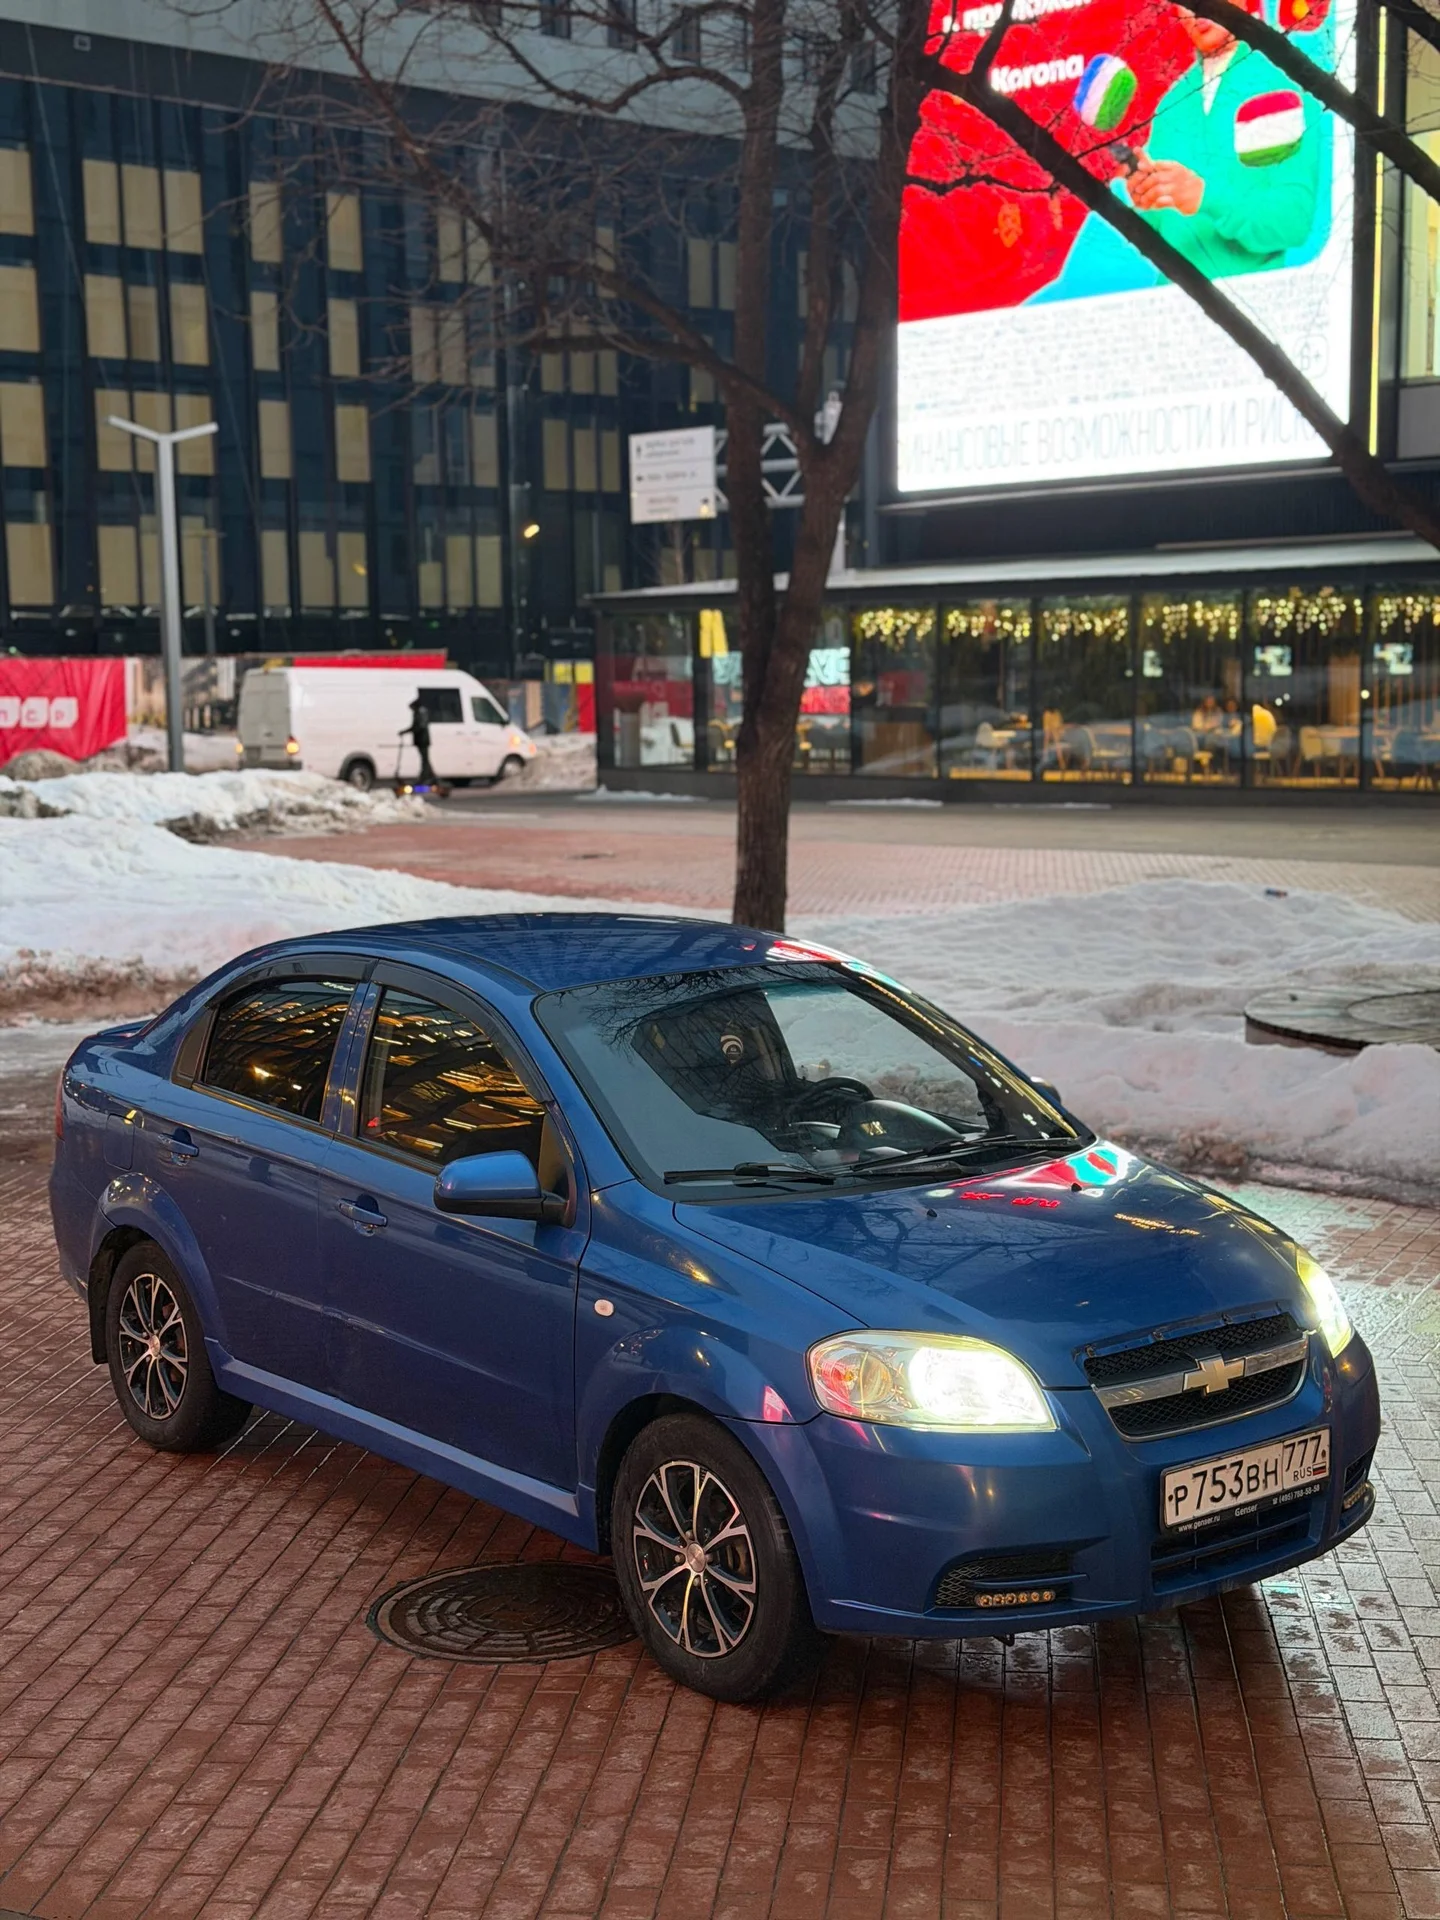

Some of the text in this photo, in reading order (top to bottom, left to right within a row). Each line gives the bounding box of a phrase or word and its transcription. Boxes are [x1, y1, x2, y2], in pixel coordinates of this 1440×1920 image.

[990, 55, 1085, 92] Korona
[899, 394, 1318, 475] ИНАНСОВЫЕ ВОЗМОЖНОСТИ И РИСК
[1283, 1434, 1322, 1473] 777
[1293, 1467, 1313, 1482] RUS
[1178, 1514, 1221, 1532] www.genser.ru
[1234, 1503, 1258, 1517] Genser
